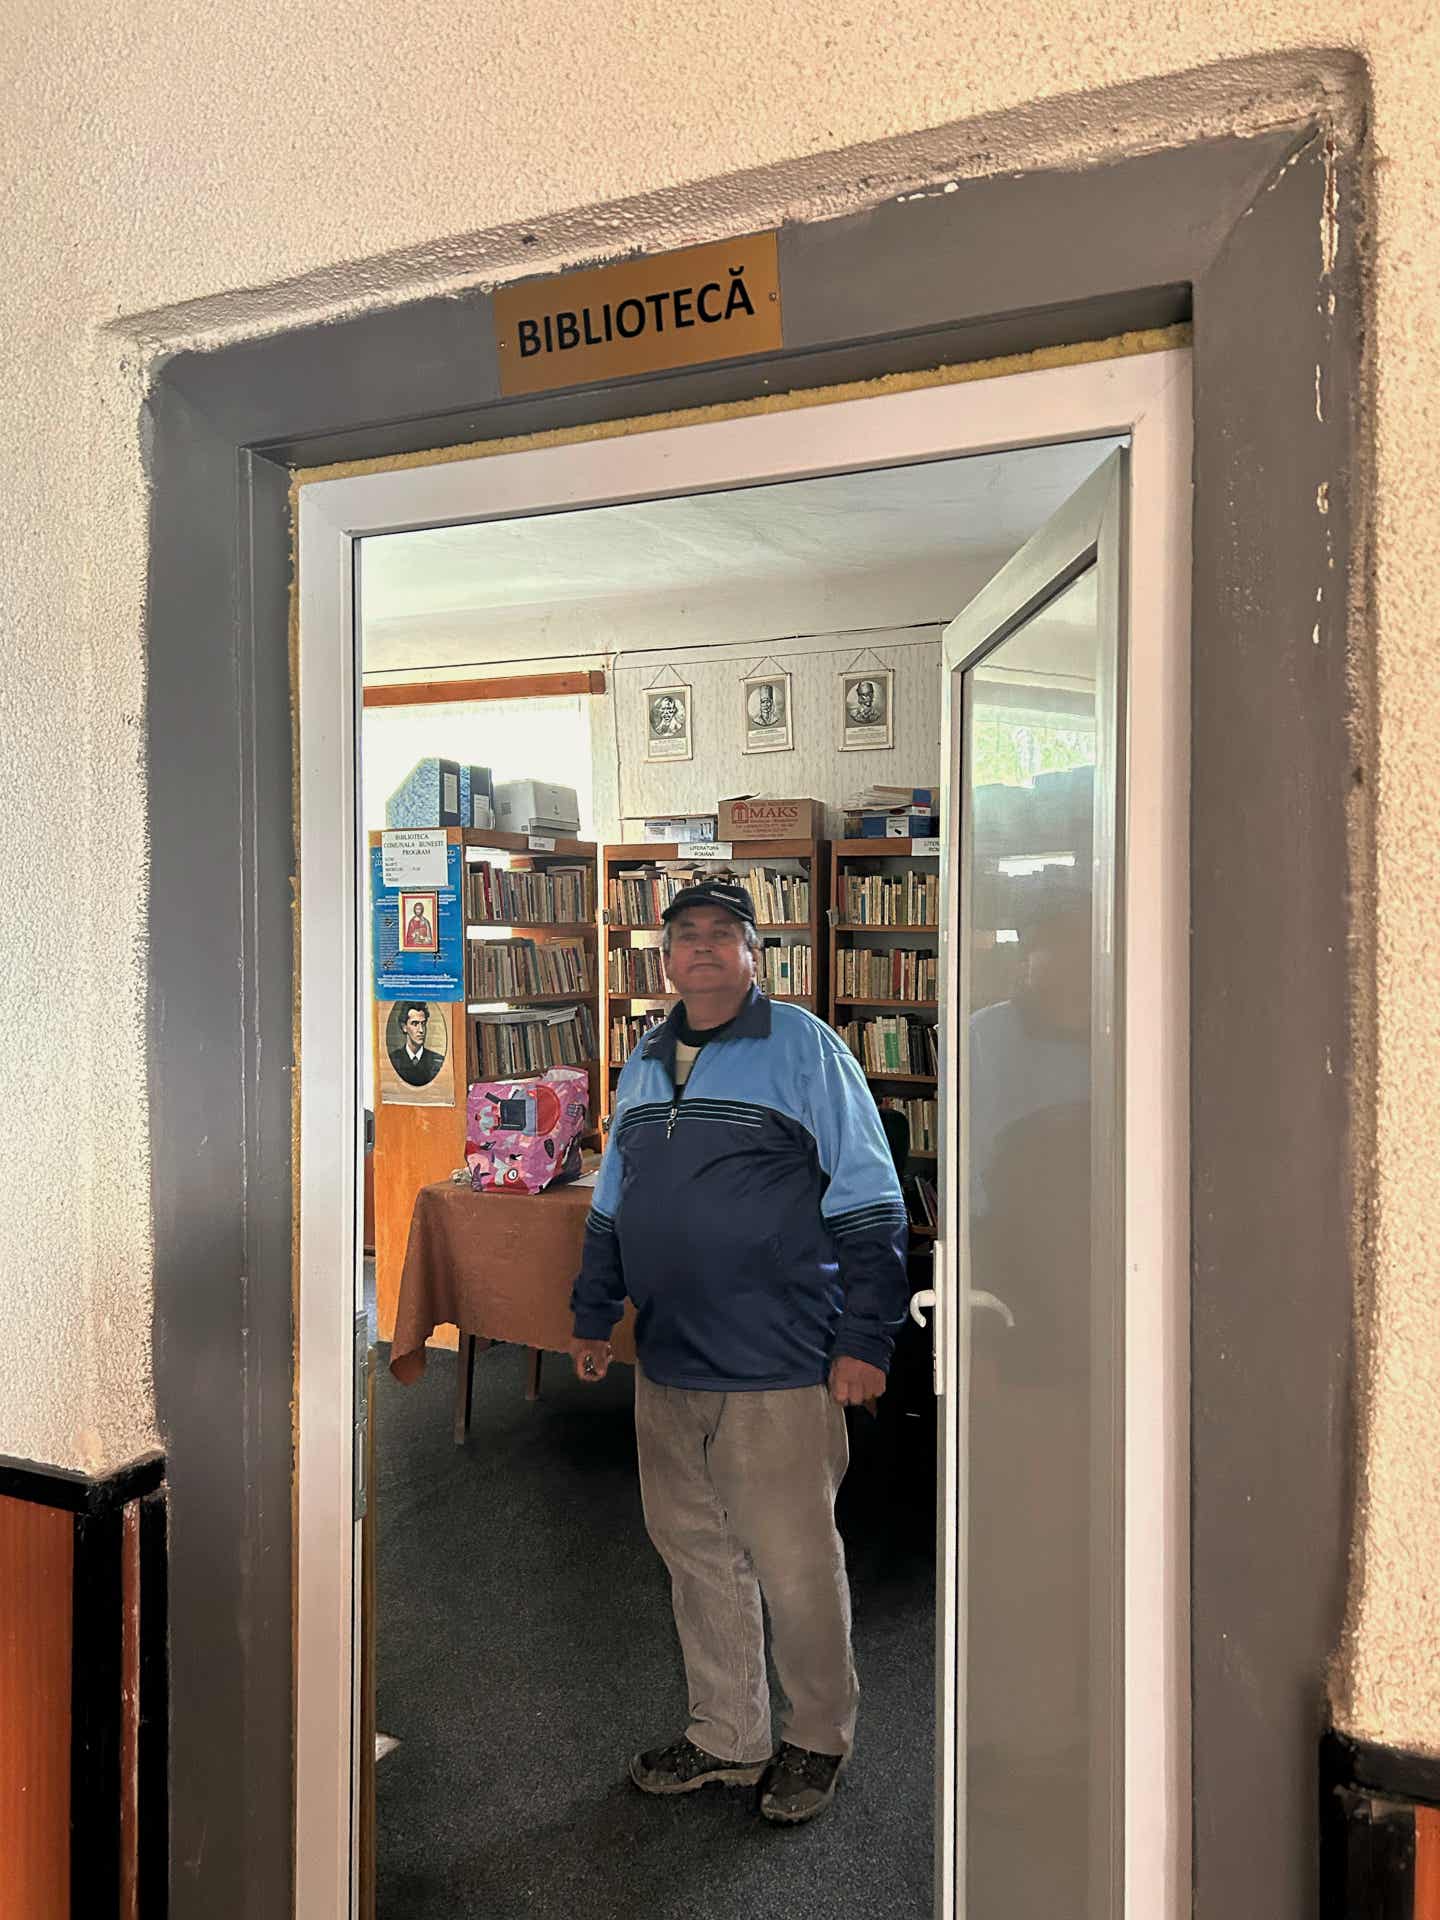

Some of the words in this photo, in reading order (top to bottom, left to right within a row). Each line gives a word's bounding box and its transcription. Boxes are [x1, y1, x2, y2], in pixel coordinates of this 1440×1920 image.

[517, 265, 755, 358] BIBLIOTECĂ
[750, 806, 799, 818] MAKS
[402, 848, 432, 856] PROGRAM
